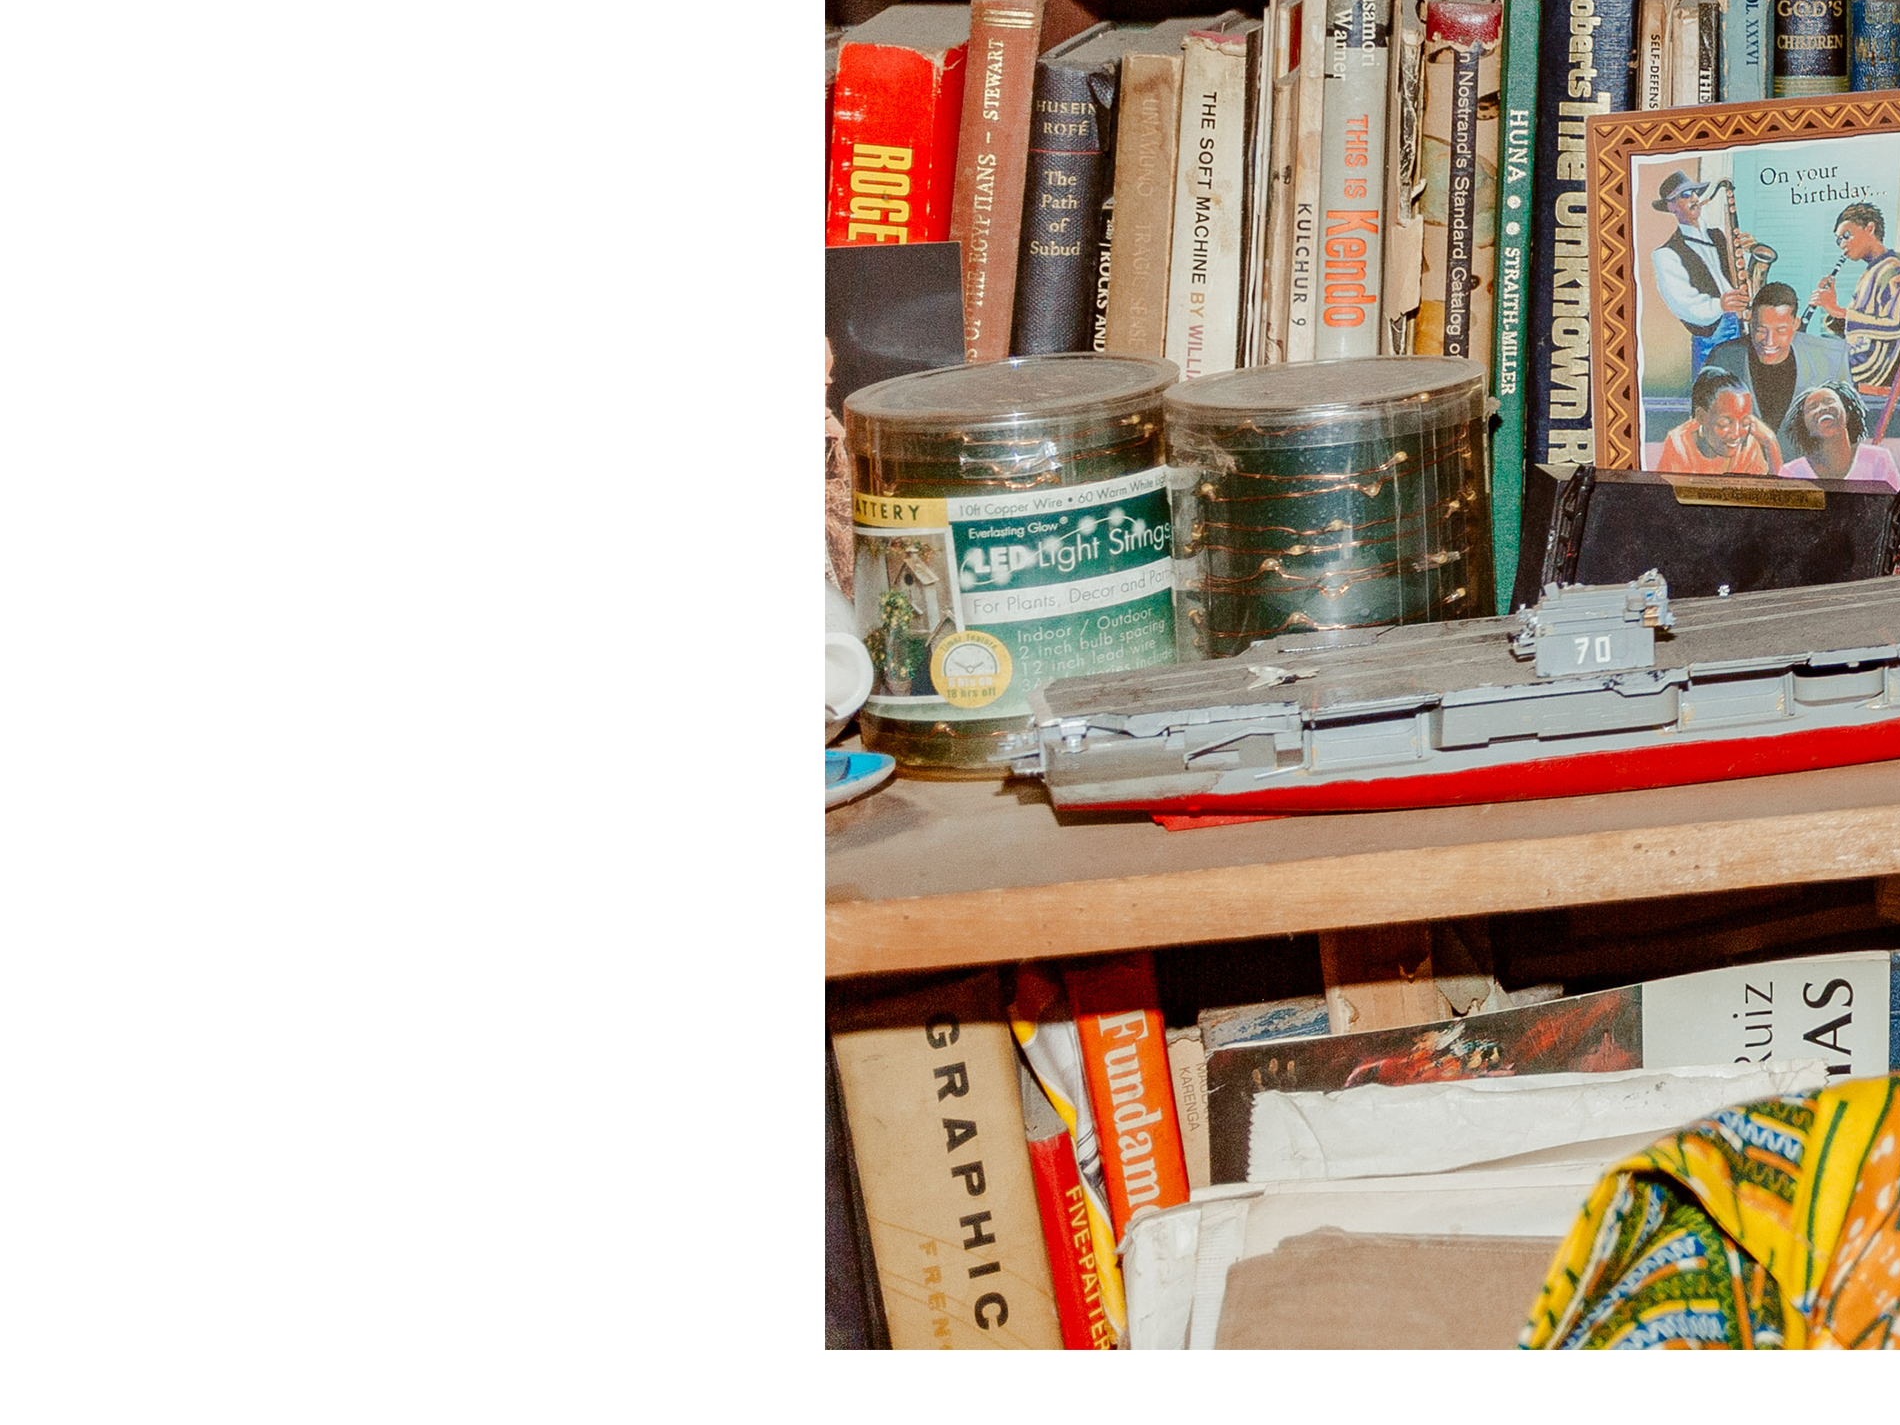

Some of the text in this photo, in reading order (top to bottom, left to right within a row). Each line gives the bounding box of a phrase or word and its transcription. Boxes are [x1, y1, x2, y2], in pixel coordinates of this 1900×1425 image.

[1776, 0, 1845, 19] GOD'S
[1744, 18, 1760, 67] XXXVI
[1776, 33, 1845, 51] CHILDREN
[981, 38, 1005, 123] STEWART
[1042, 120, 1091, 137] ROFÉ
[1045, 171, 1079, 188] The
[1759, 165, 1839, 187] On your
[968, 151, 998, 256] EGYPTIANS
[1040, 193, 1080, 210] Path
[1188, 90, 1219, 319] THE SOFT MACHINE BY
[1323, 113, 1379, 330] THIS IS Kendo
[1447, 70, 1473, 337] Nostrand's Standard Catalog
[1048, 216, 1071, 234] of
[1029, 240, 1082, 258] Subud
[1291, 202, 1313, 307] KULCHUR
[1500, 108, 1529, 398] HUNA STRAITH-MILLER
[1549, 192, 1590, 420] Unknown
[1091, 312, 1110, 353] AND
[983, 479, 1154, 519] Copper Wire 60 Warm White
[967, 520, 1059, 541] Everlasting Glow
[973, 521, 1173, 575] LED Light Strings
[972, 576, 1146, 616] For Decor and
[1016, 606, 1154, 645] Indoor Outdoor
[1017, 618, 1167, 662] 2 inch bulb spacing
[1051, 638, 1159, 671] inch lead wire
[1573, 635, 1614, 665] 70
[1178, 1066, 1202, 1133] KARENGA
[924, 1010, 1010, 1332] GRAPHIC
